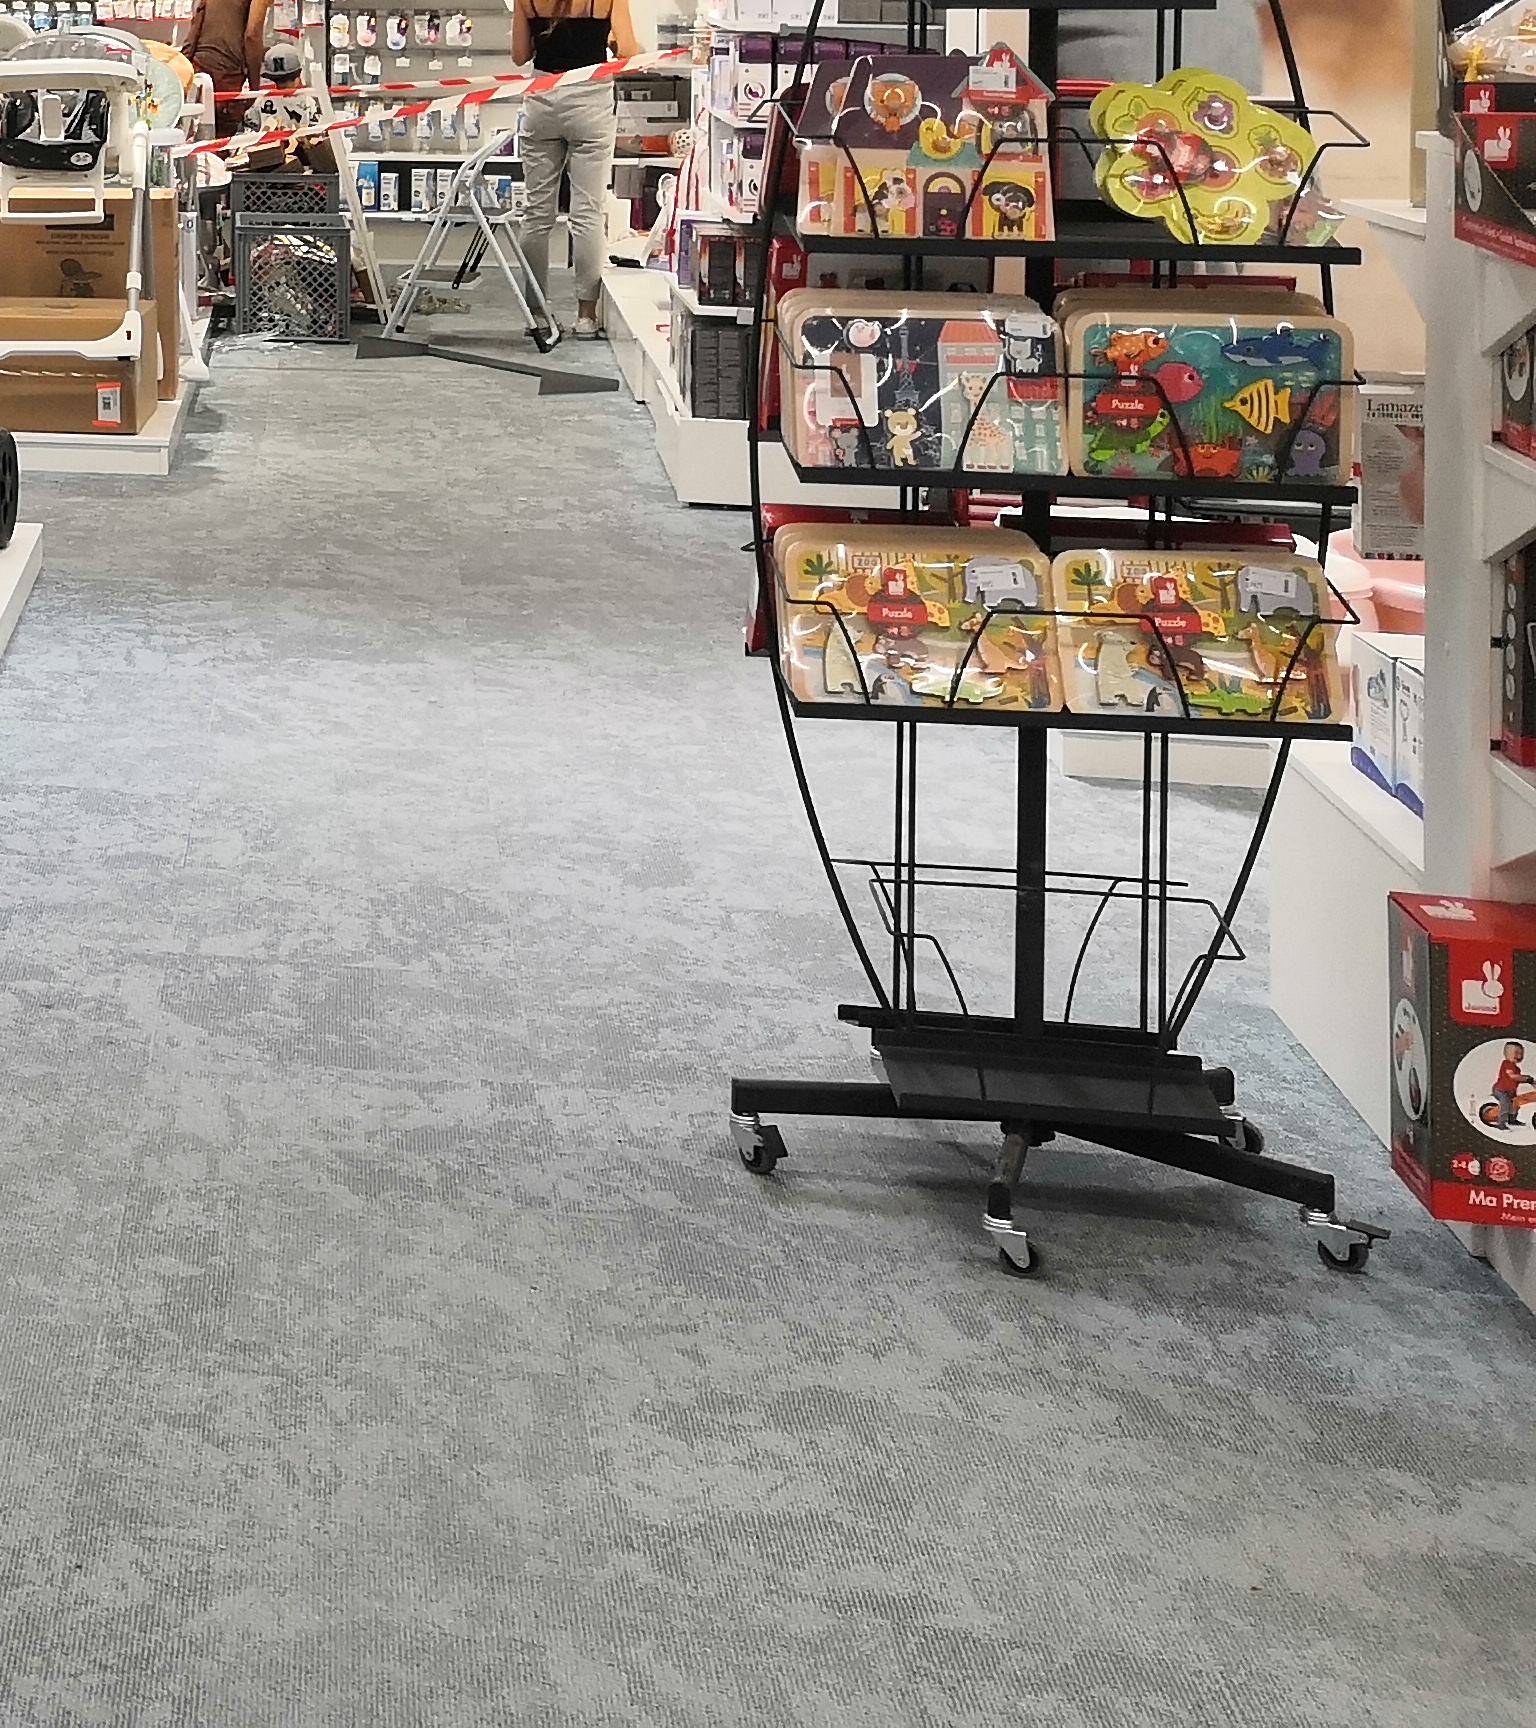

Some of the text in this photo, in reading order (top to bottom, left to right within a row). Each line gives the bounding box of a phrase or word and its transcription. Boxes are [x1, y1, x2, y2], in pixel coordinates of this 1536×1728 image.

[1112, 399, 1144, 410] Puzzle
[882, 607, 913, 618] Puzzle
[1469, 1189, 1497, 1206] Ma
